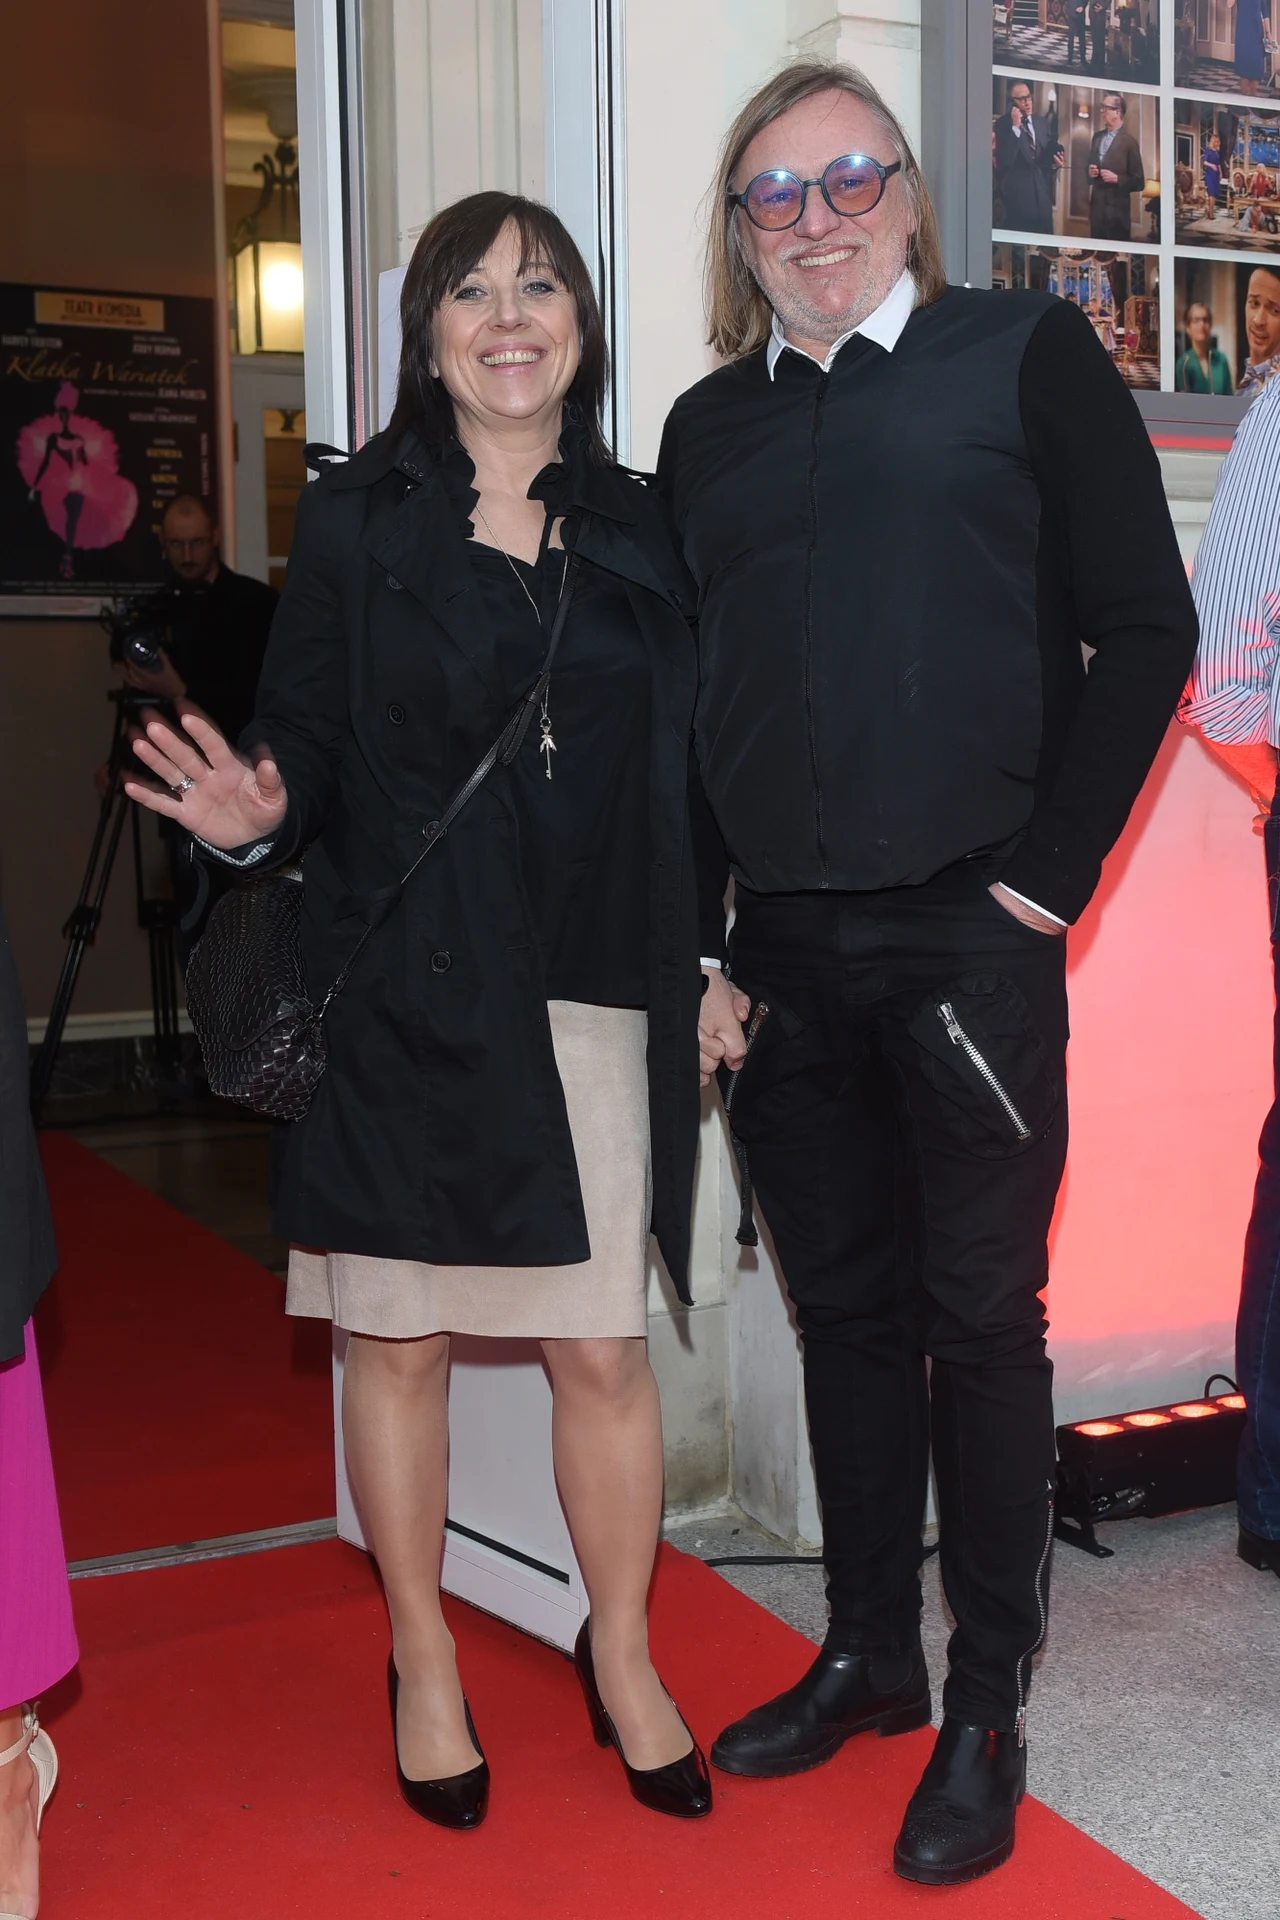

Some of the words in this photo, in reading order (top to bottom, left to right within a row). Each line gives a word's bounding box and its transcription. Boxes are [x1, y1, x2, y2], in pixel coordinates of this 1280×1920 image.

[64, 299, 94, 314] TEATR
[97, 302, 142, 318] KOMEDIA
[6, 350, 81, 382] Klatka
[91, 359, 199, 385] Wariatek
